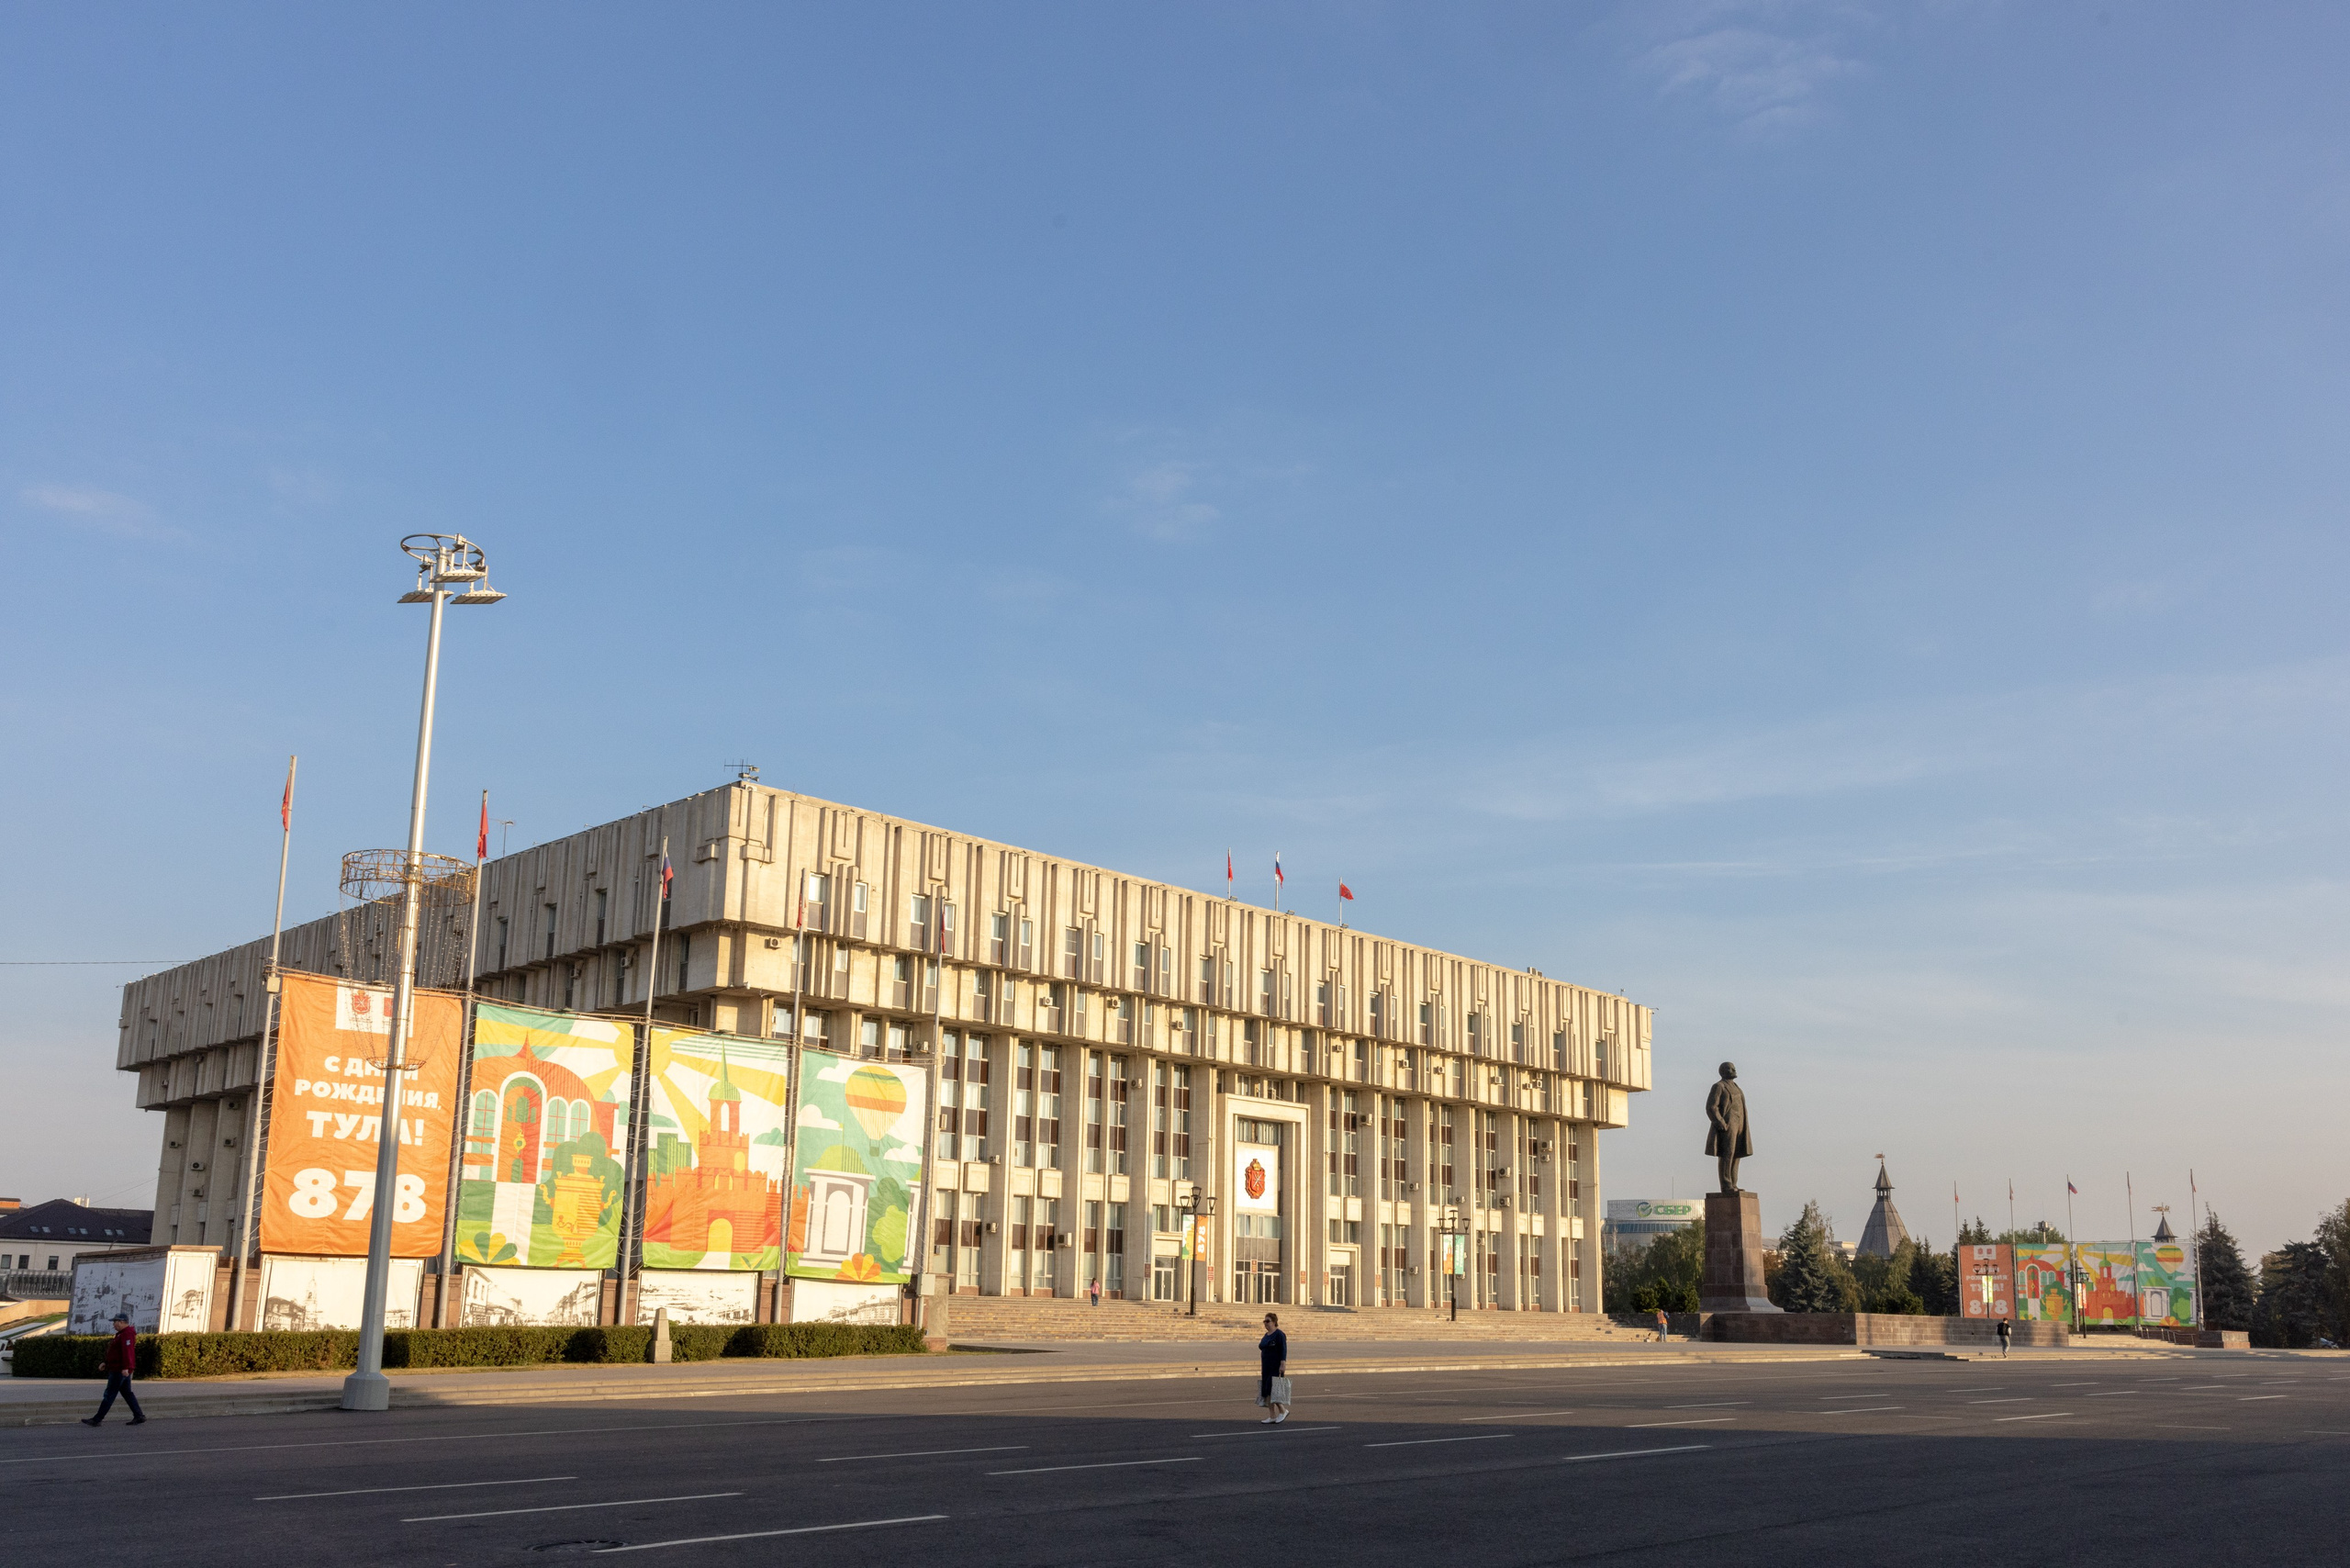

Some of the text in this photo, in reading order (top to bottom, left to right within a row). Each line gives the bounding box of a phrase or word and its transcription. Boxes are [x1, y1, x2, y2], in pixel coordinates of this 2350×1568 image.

[324, 1055, 341, 1072] С
[288, 1167, 427, 1224] 878
[1655, 1204, 1691, 1215] СБЕР
[1197, 1226, 1206, 1254] 878
[1970, 1283, 2004, 1292] ТУА!
